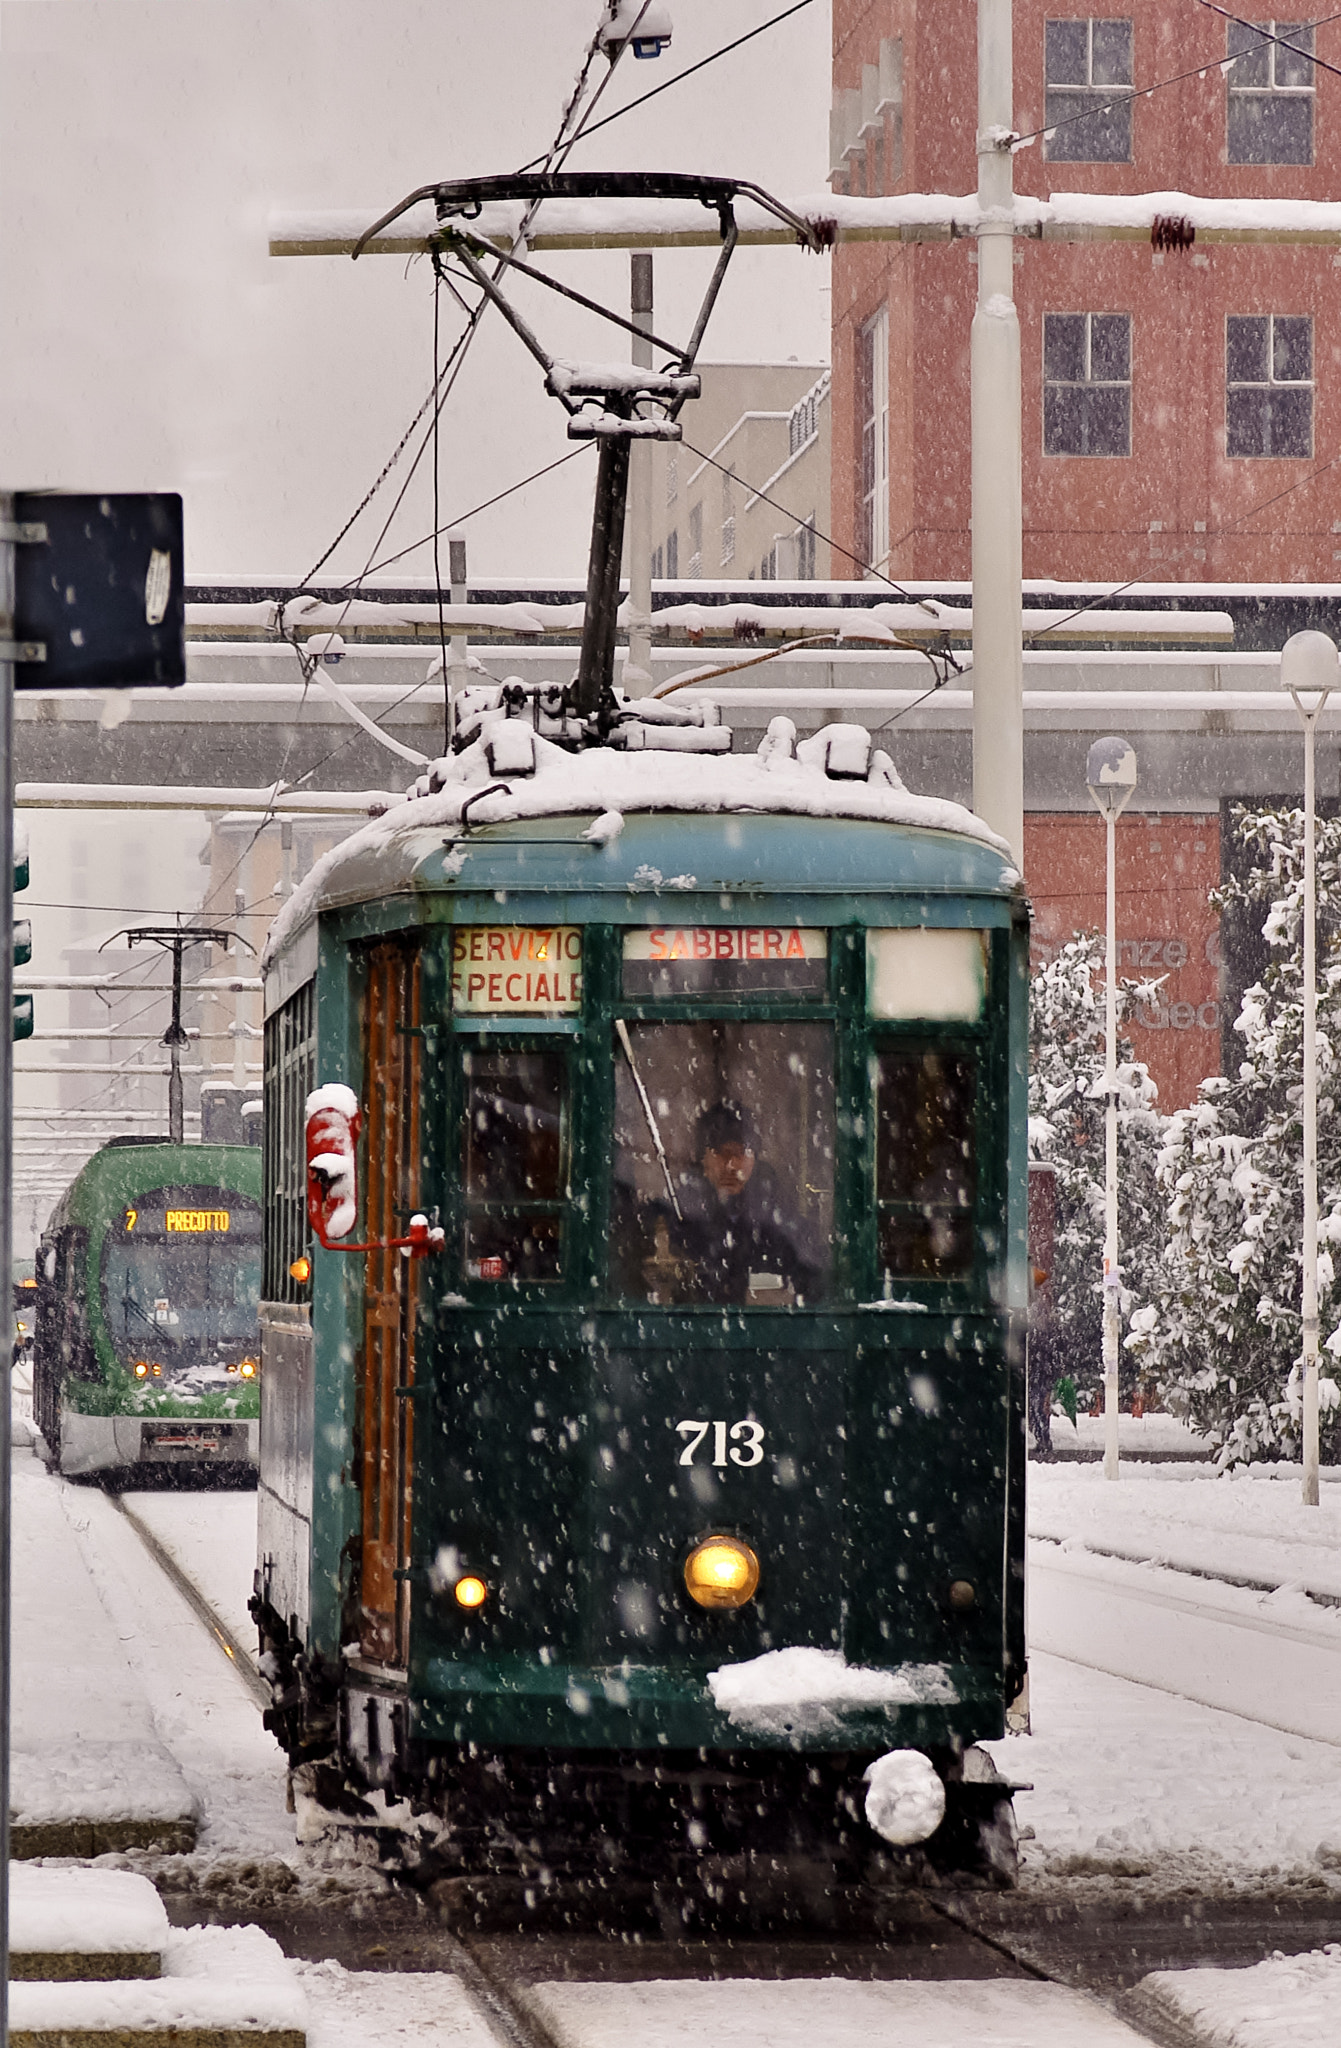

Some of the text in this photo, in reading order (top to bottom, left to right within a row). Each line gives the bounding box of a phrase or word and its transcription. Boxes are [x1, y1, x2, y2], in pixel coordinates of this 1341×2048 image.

[453, 930, 581, 961] SERVIZIO
[650, 929, 805, 960] SABBIERA
[452, 973, 582, 1002] SPECIALE
[126, 1210, 230, 1232] 7 PRECOTTO
[675, 1420, 765, 1467] 713
